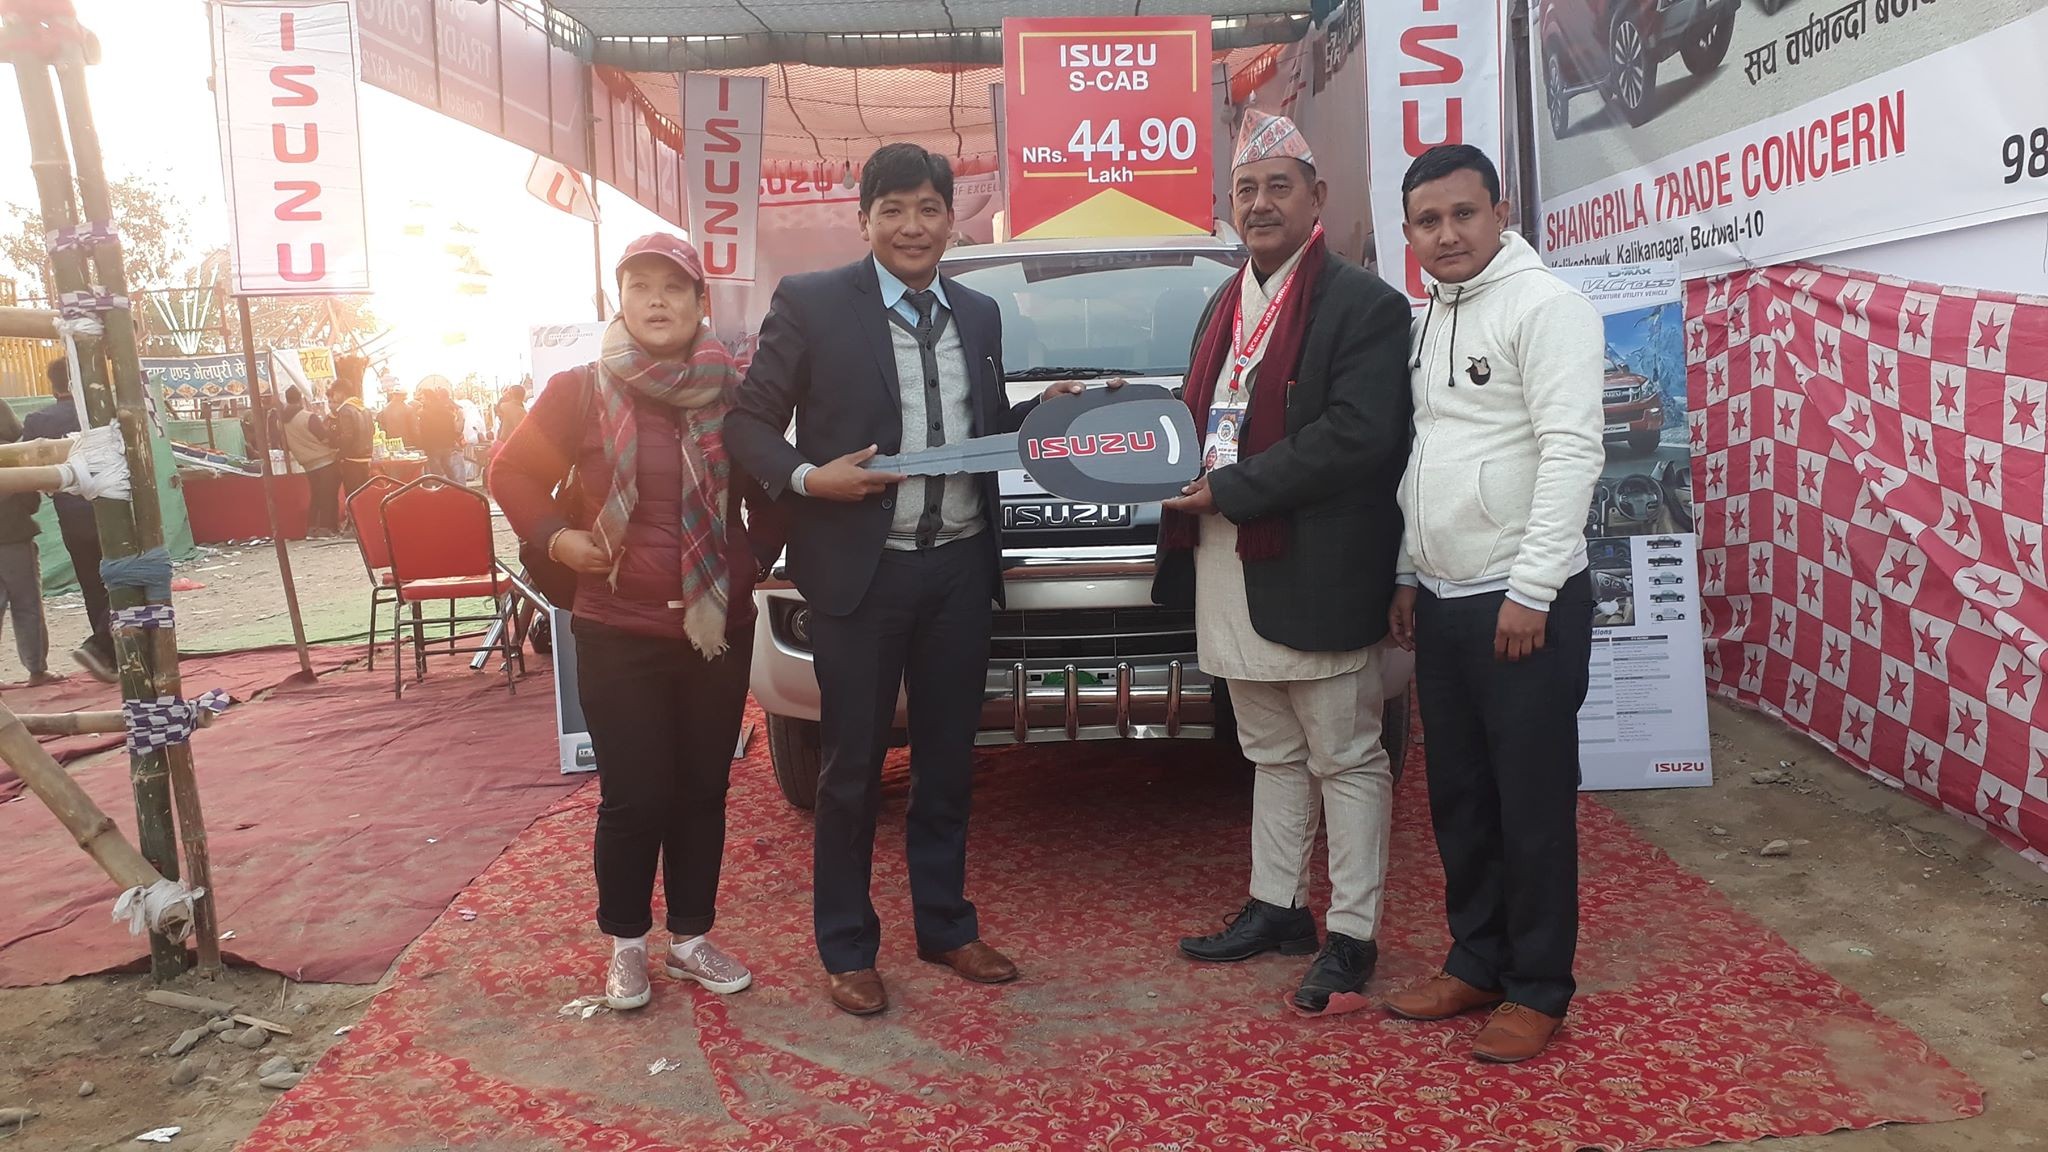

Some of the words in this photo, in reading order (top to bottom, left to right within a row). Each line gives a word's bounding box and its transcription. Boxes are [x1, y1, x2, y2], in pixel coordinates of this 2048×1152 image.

[1060, 44, 1156, 67] ISUZU
[1744, 40, 1778, 86] सय
[1069, 71, 1149, 91] S-CAB
[269, 13, 325, 281] ISUZU
[1022, 147, 1067, 163] NRs.
[1068, 117, 1196, 161] 44.90
[704, 77, 742, 275] ISUZU
[1088, 166, 1133, 183] Lakh
[1546, 183, 1649, 252] SHANGRILA
[1654, 152, 1733, 222] TRADE
[1741, 89, 1906, 198] CONCERN
[1616, 233, 1689, 264] Kalikanagar,
[1690, 209, 1764, 251] Butwal-10
[1644, 289, 1669, 297] VEHICLE
[1028, 431, 1157, 460] ISUZU
[1004, 503, 1127, 528] ISUZU
[1655, 762, 1704, 773] ISUZU
